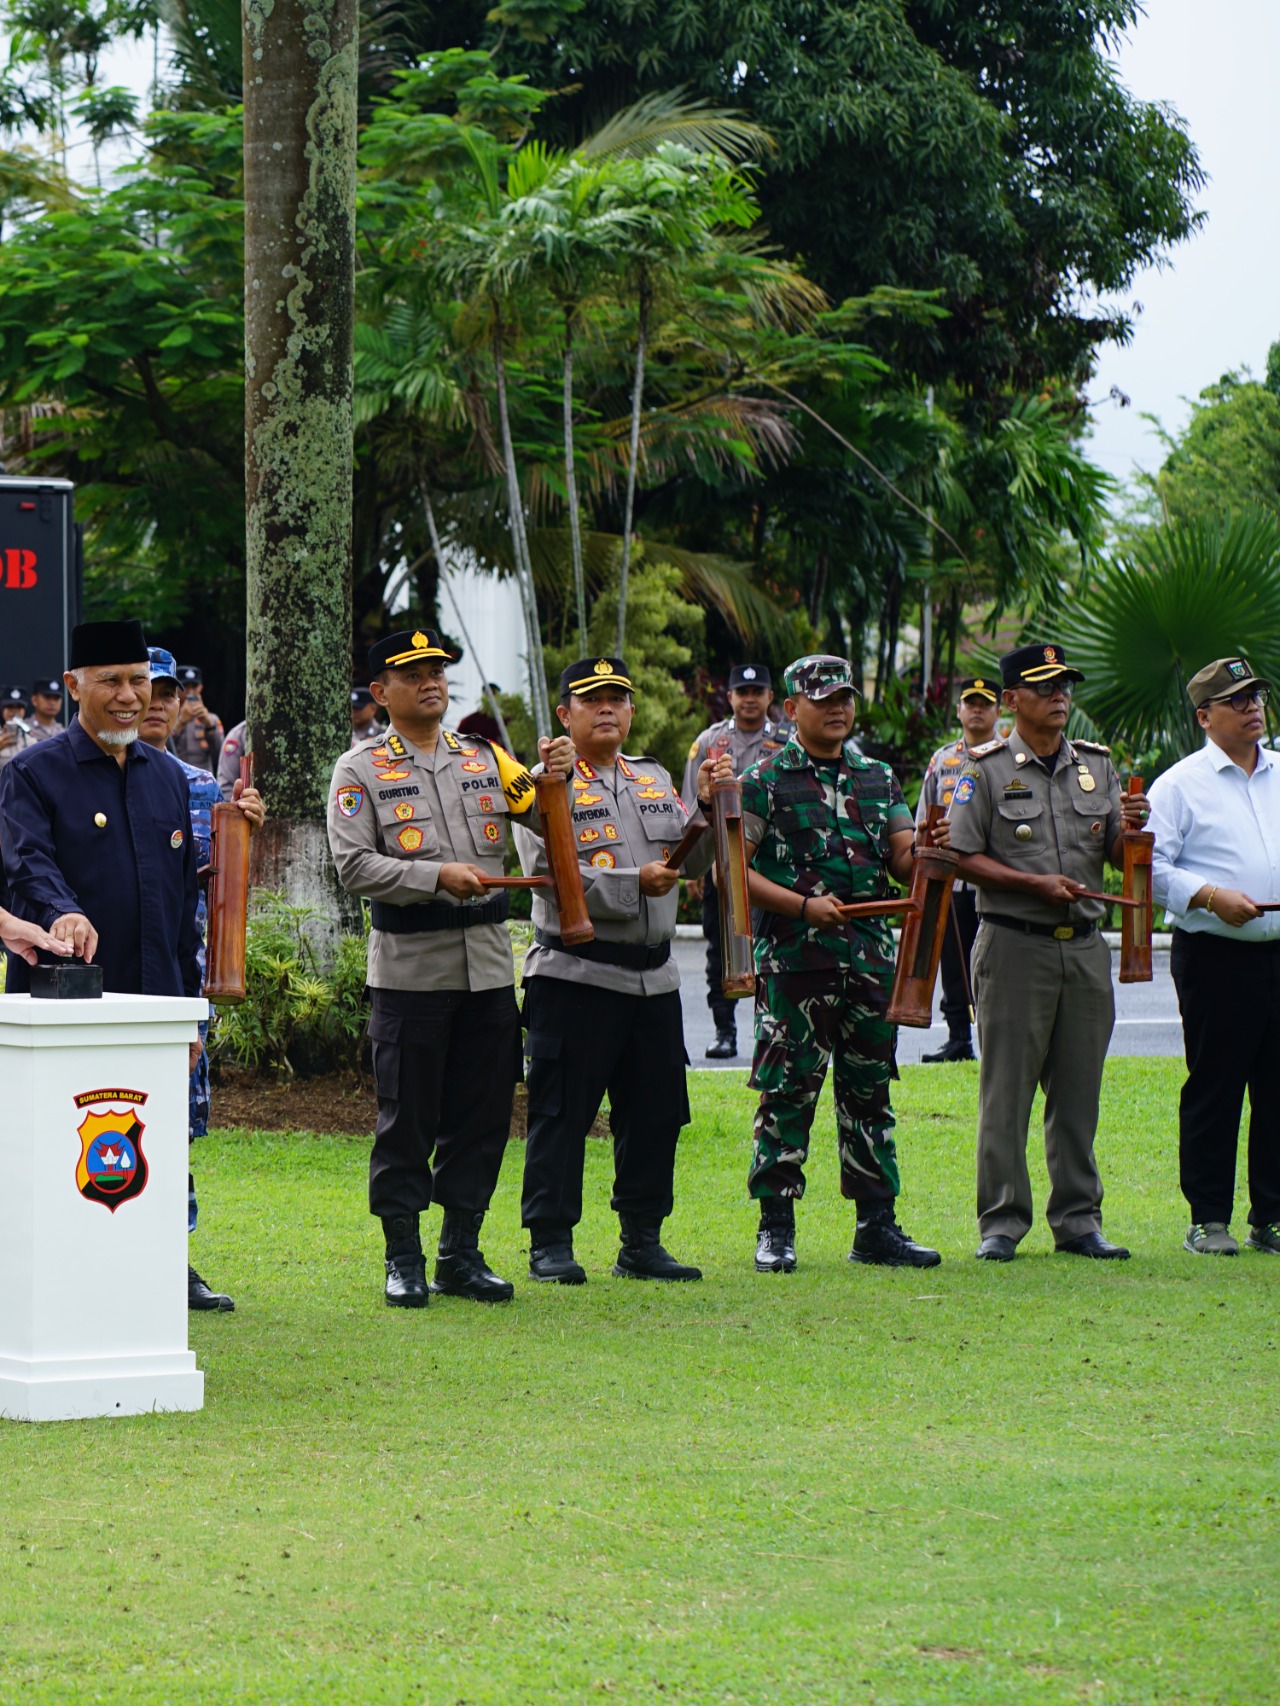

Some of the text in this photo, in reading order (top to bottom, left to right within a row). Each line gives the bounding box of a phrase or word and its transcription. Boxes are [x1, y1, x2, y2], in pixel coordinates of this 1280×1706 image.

[462, 777, 499, 792] POLRI
[378, 785, 420, 801] GURITNO
[573, 808, 611, 823] RAYENDRA
[640, 803, 673, 815] POLRI
[79, 1091, 143, 1104] SUMATERA BARAT
